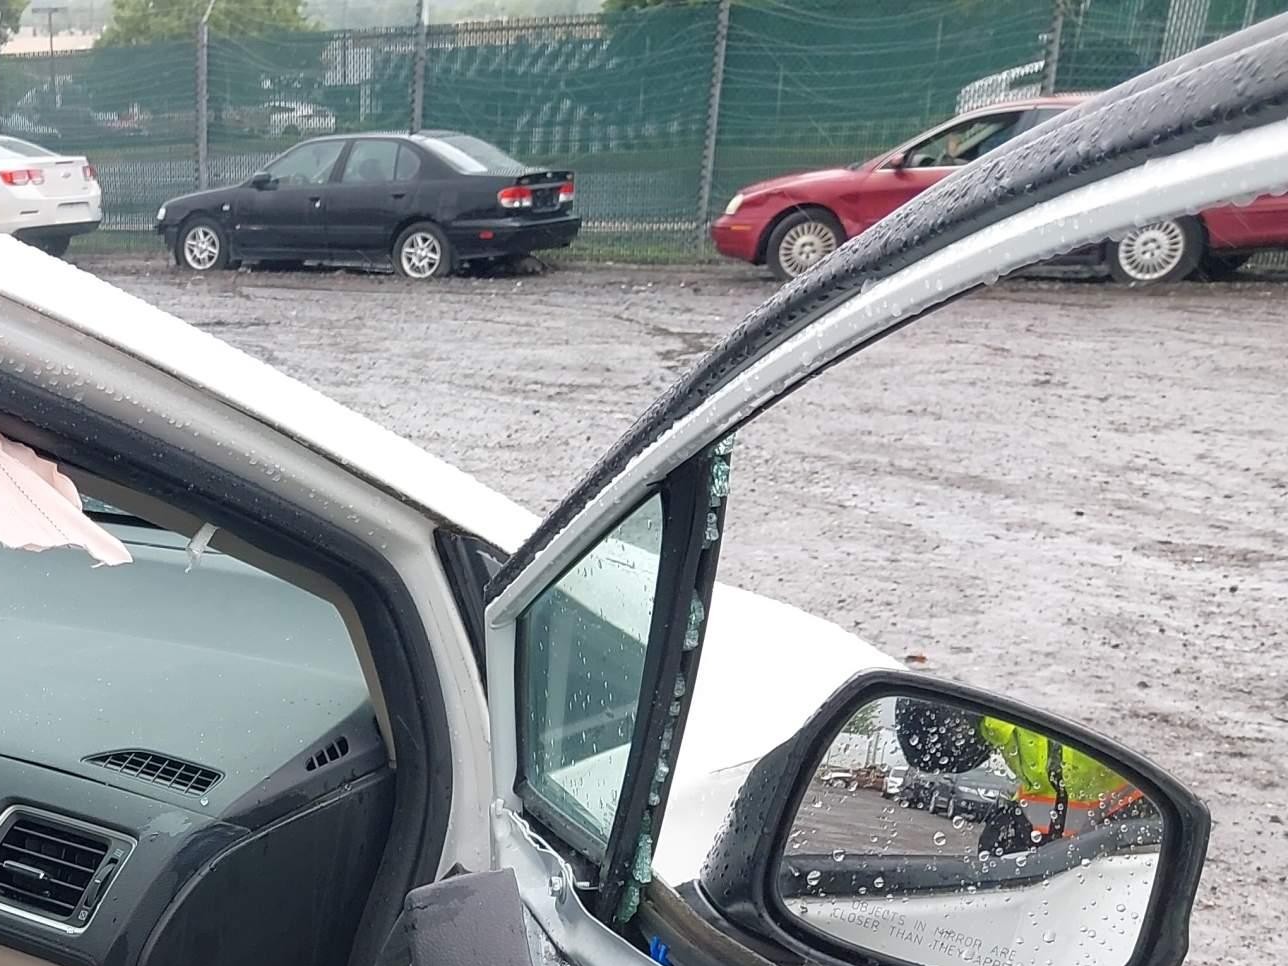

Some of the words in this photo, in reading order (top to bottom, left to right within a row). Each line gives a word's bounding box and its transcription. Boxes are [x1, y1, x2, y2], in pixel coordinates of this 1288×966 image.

[832, 907, 880, 930] CLOSER
[889, 926, 924, 945] THAN
[933, 939, 963, 958] THEY
[851, 900, 907, 926] OBJECTS
[913, 919, 927, 932] IN
[934, 926, 983, 950] MIRROR
[990, 945, 1017, 962] ARE
